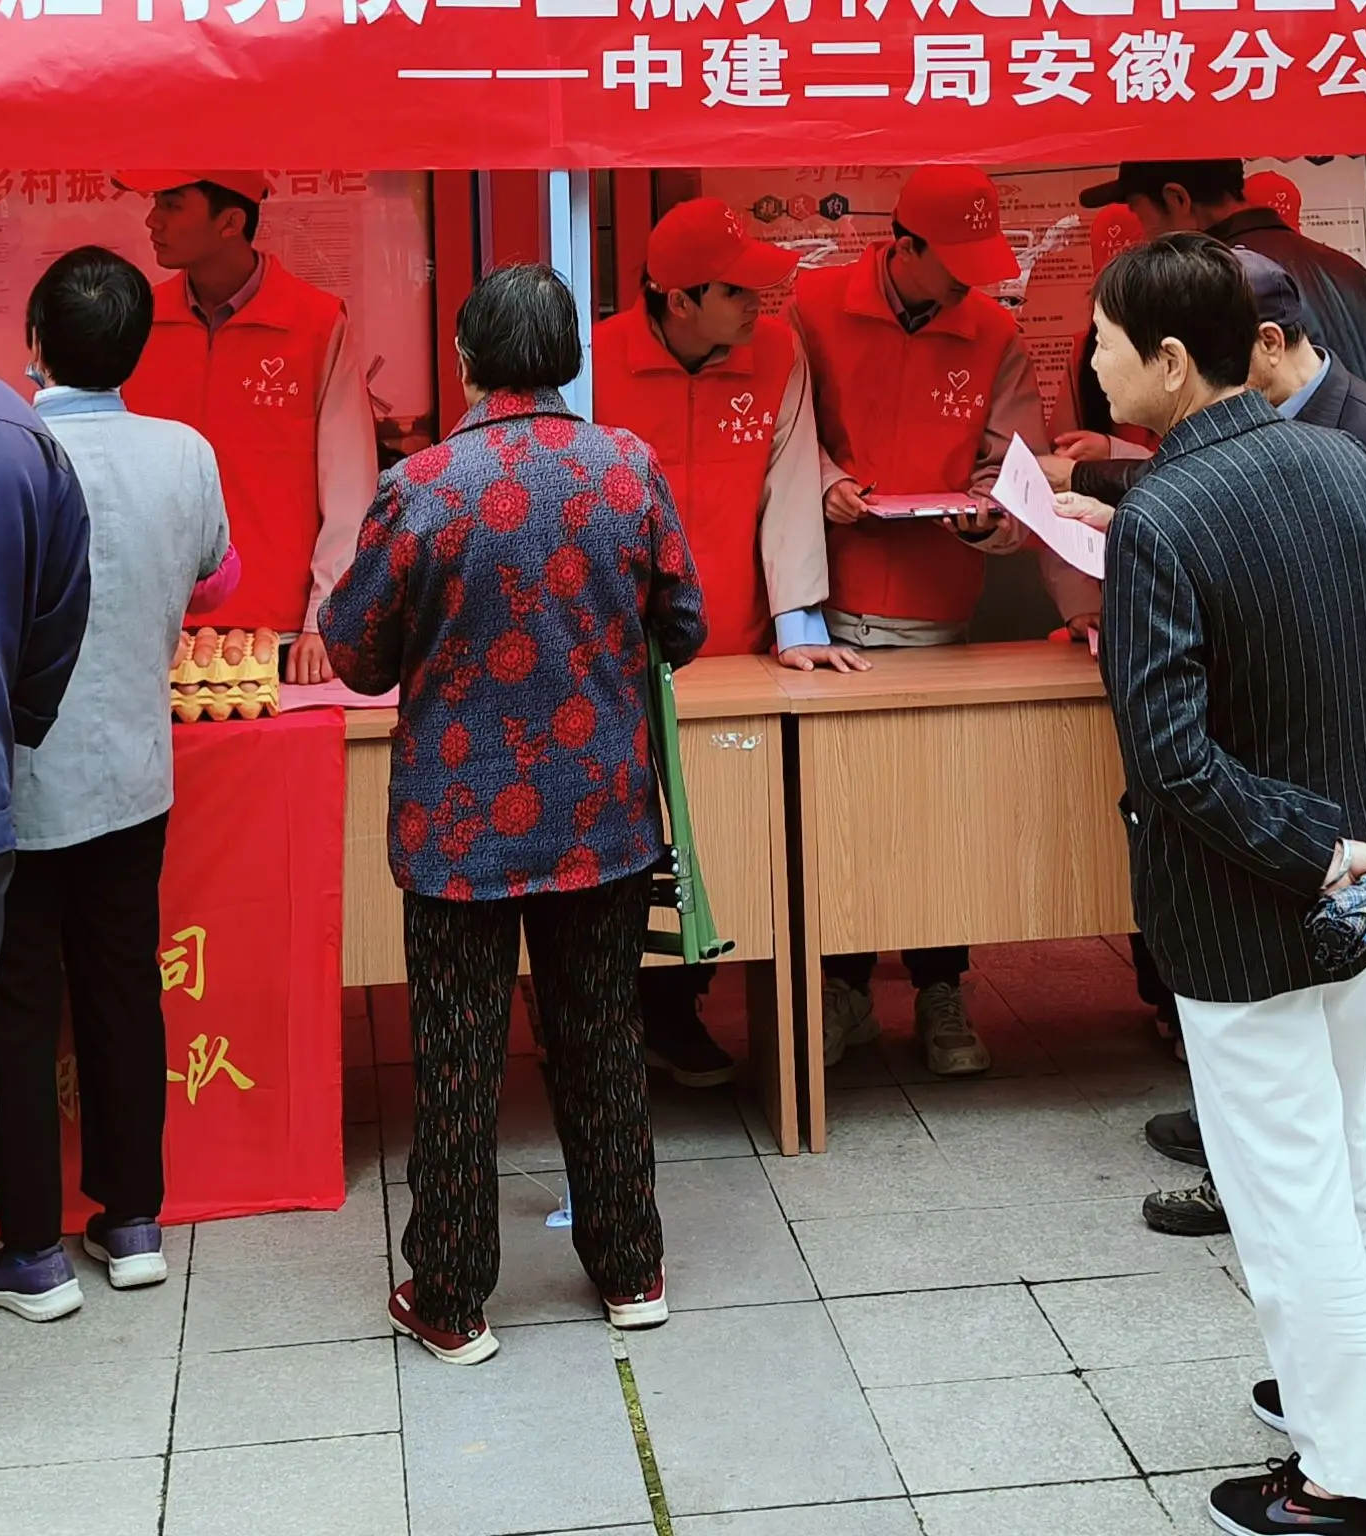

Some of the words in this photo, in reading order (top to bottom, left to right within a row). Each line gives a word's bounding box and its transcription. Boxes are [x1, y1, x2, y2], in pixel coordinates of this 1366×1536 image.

[717, 410, 774, 433] 中建二局
[166, 1032, 256, 1106] 队
